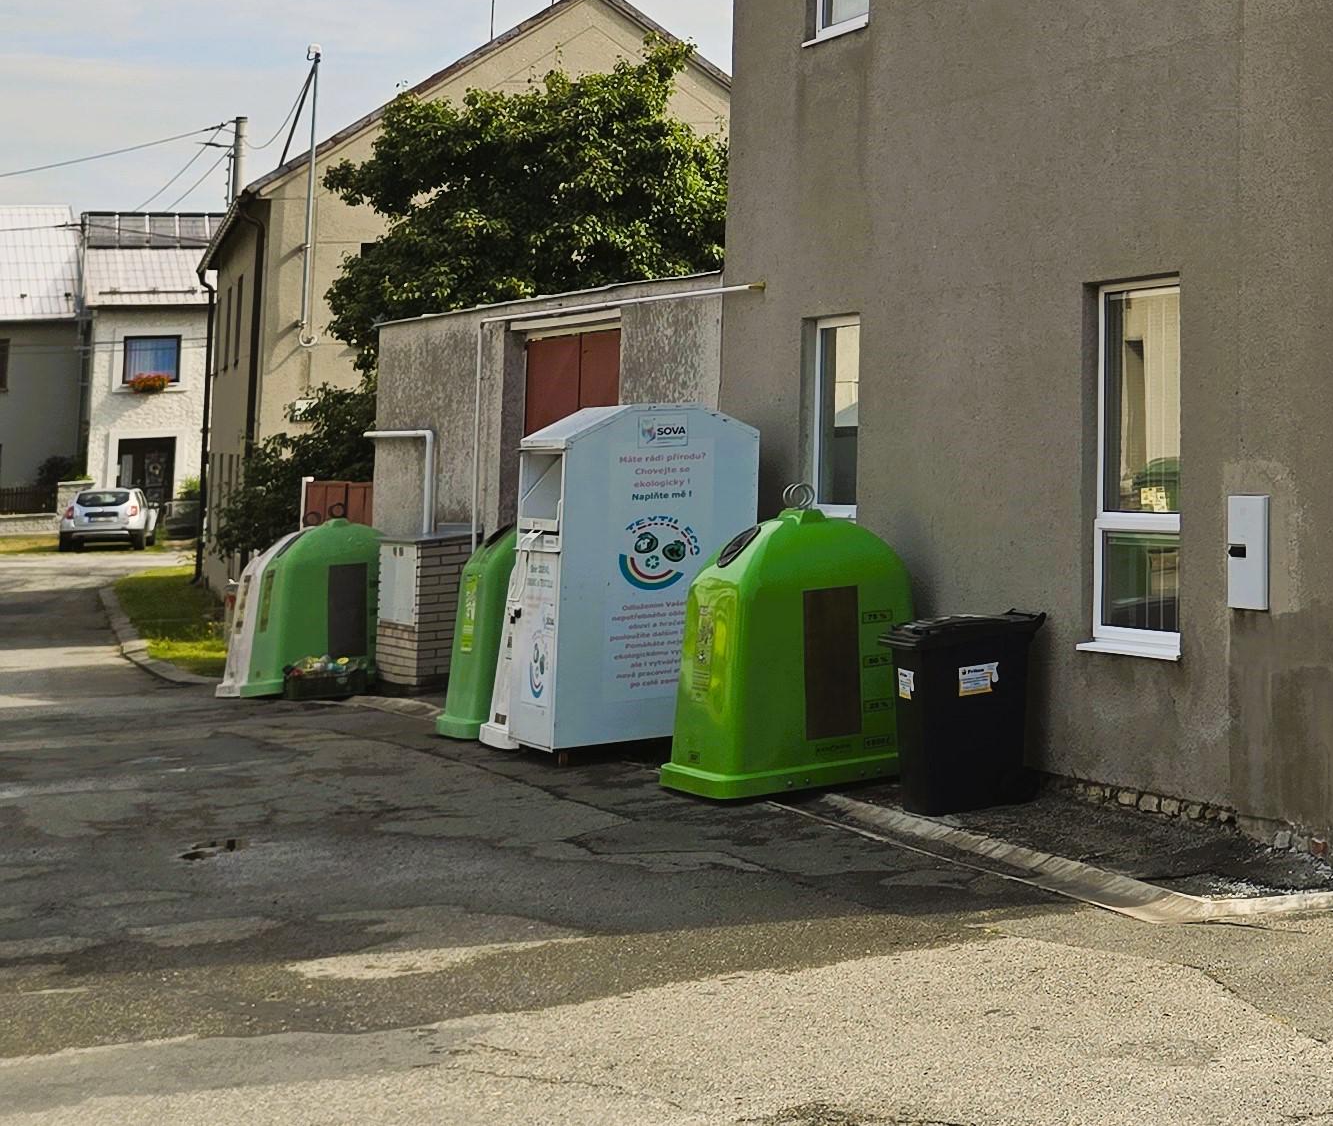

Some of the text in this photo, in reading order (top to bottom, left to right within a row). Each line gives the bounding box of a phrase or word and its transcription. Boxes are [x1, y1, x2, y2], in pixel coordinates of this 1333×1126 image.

[656, 426, 686, 436] SOVA
[634, 466, 678, 476] Chovejte
[625, 515, 700, 556] TEXTIL ECO
